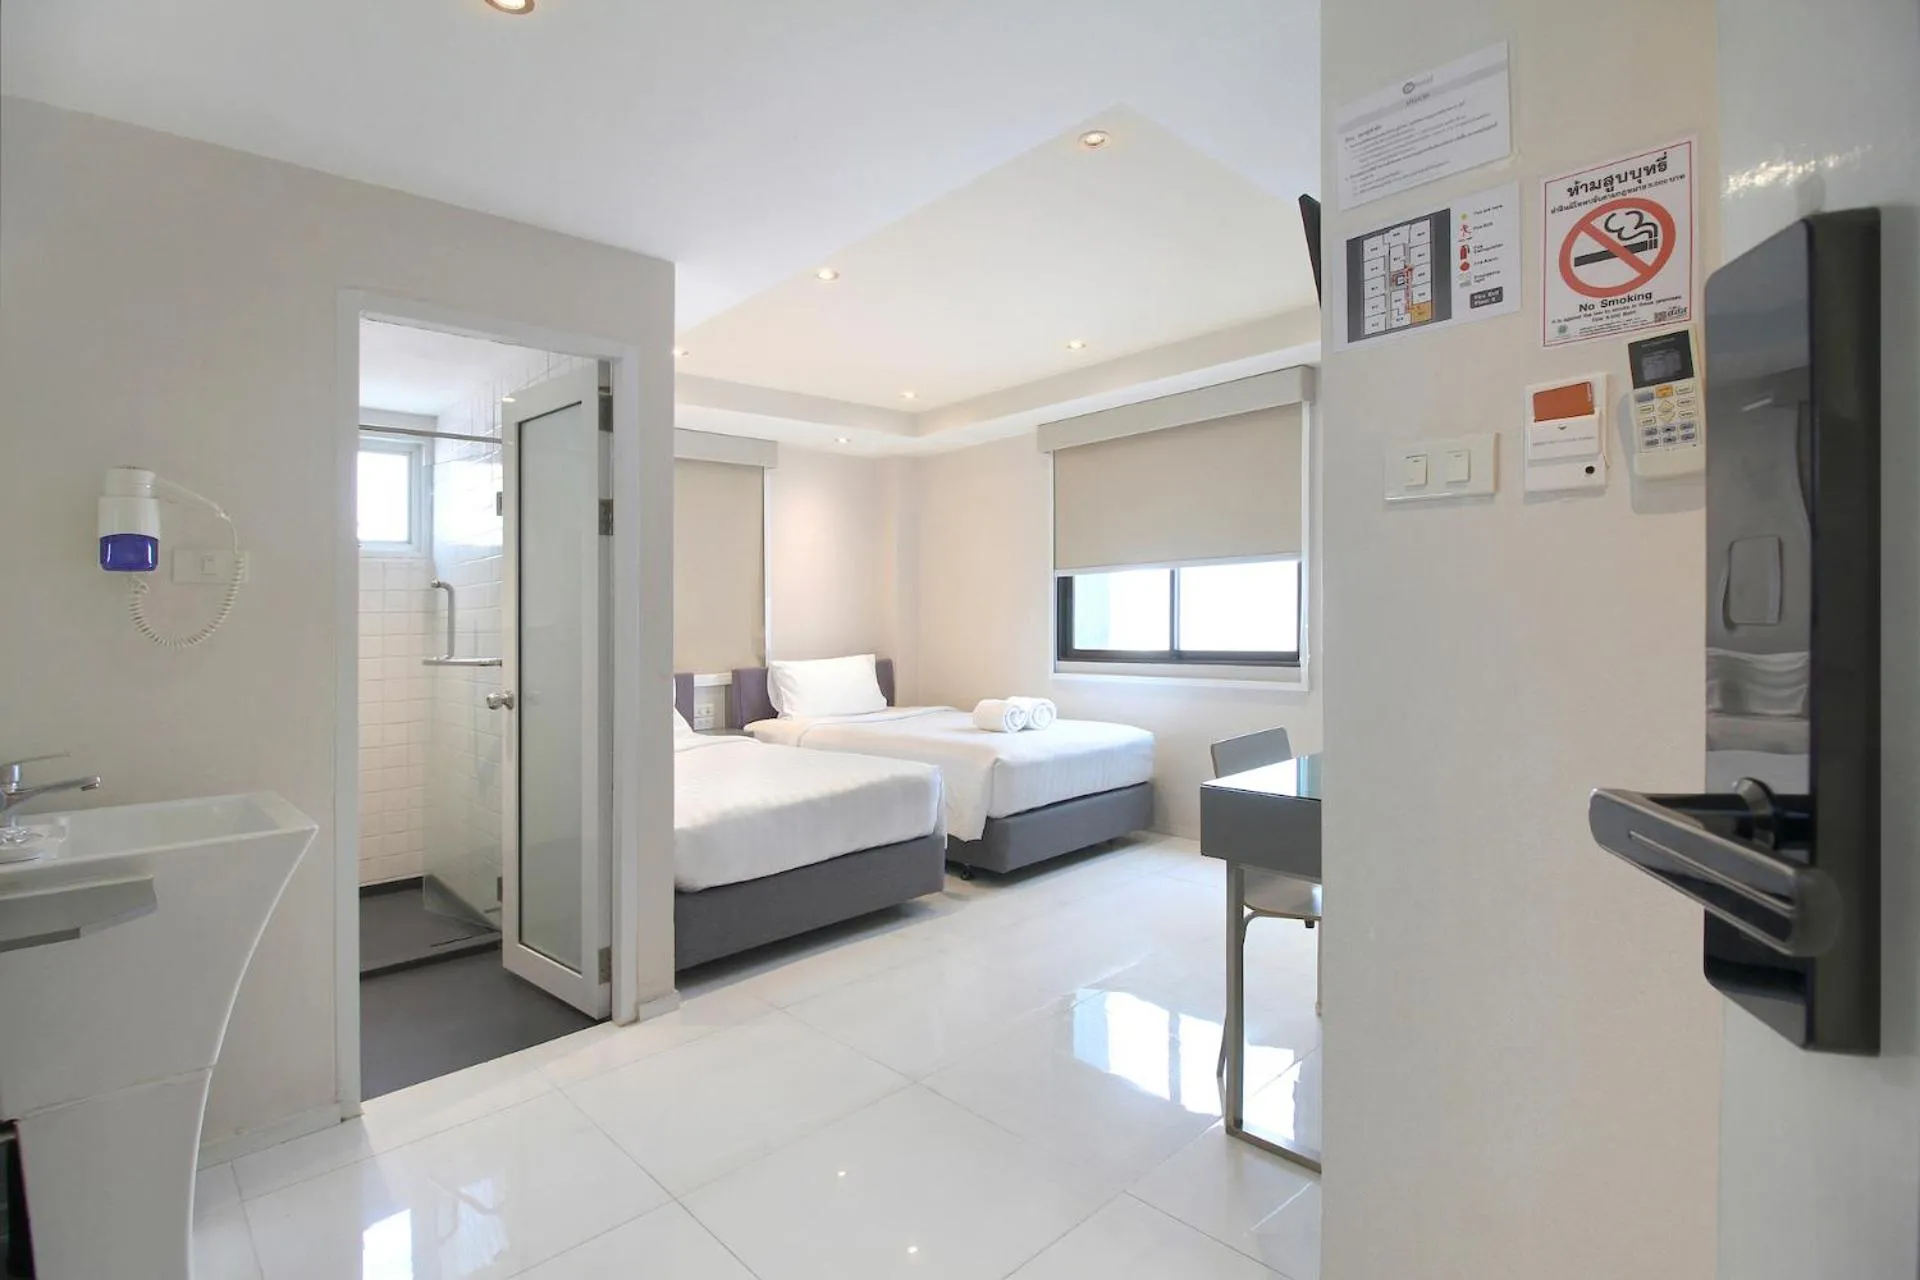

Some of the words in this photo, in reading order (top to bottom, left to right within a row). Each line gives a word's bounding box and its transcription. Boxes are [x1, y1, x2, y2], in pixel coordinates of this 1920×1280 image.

[1567, 151, 1668, 197] ห้ามสูบบุหรี่
[1579, 303, 1595, 312] No
[1600, 291, 1653, 308] Smoking
